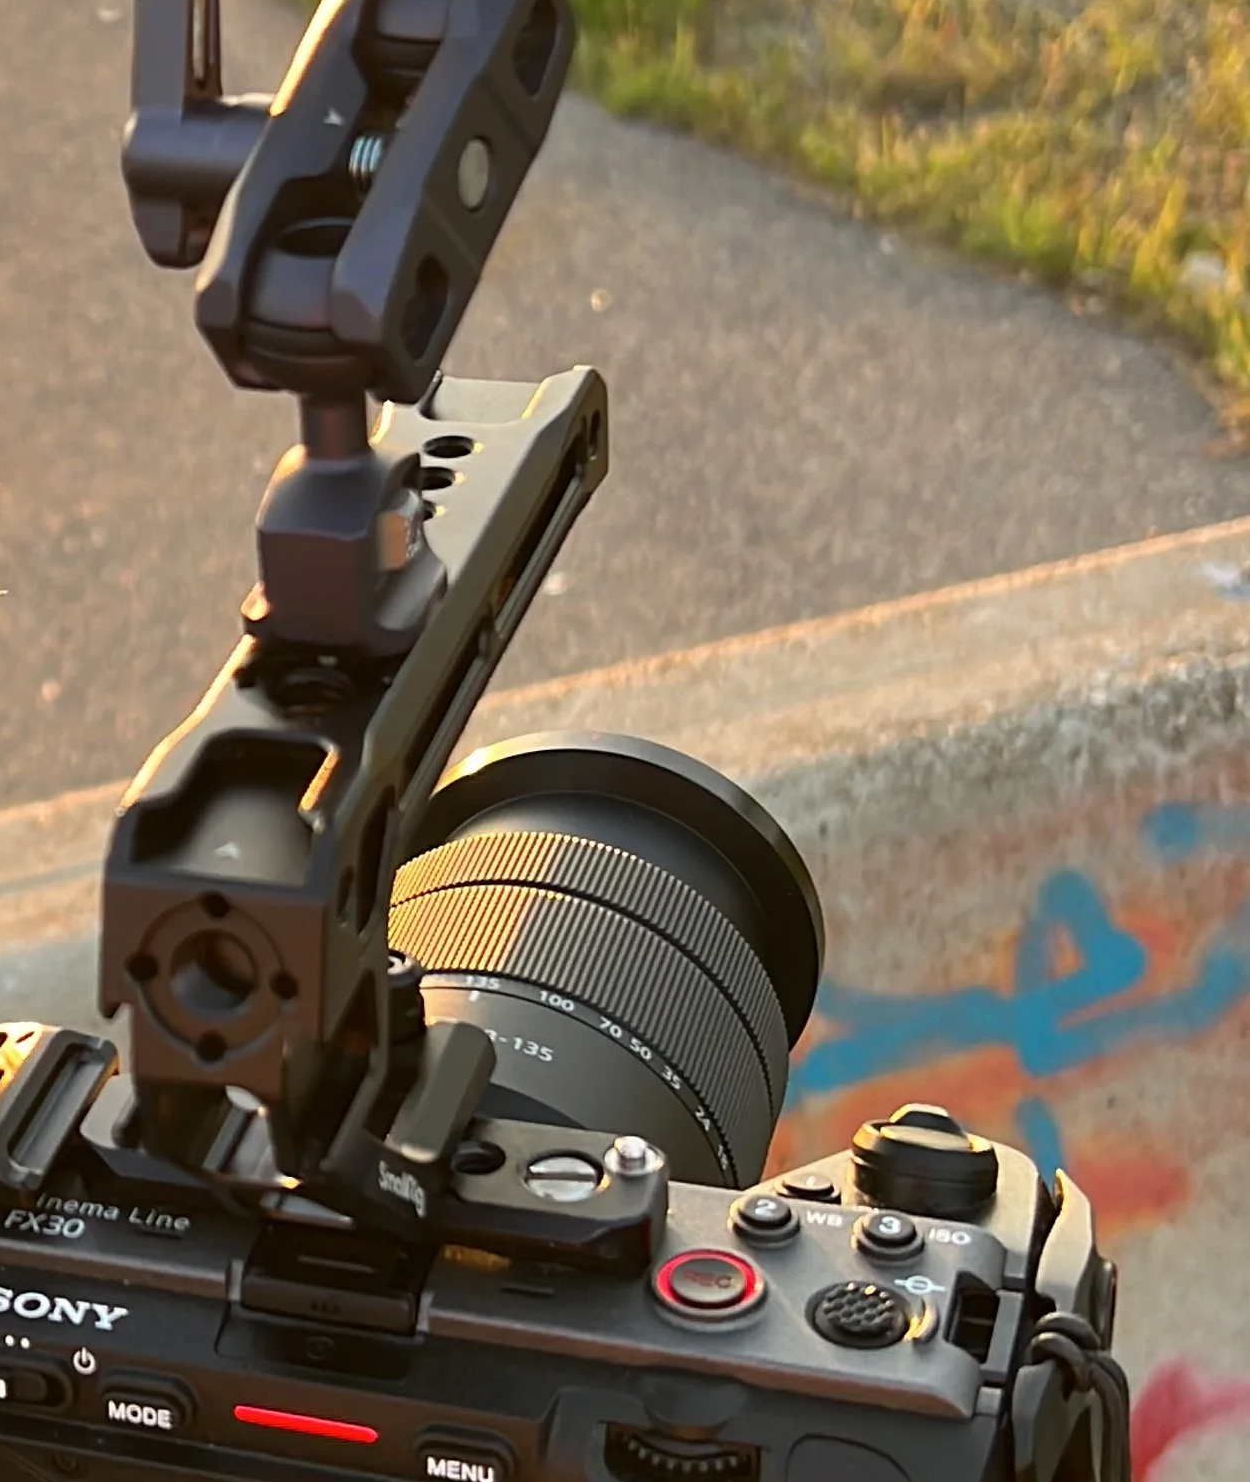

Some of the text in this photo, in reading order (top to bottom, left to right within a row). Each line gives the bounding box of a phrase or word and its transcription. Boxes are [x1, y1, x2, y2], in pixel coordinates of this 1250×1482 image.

[538, 989, 575, 1013] 100
[598, 1017, 623, 1040] 70
[629, 1037, 652, 1061] 50
[661, 1065, 682, 1091] 35
[4, 1209, 86, 1239] FX30
[36, 1192, 192, 1231] inema Line
[754, 1200, 843, 1228] 2 WB
[879, 1216, 972, 1245] 3 ISO
[108, 1400, 173, 1429] MODE
